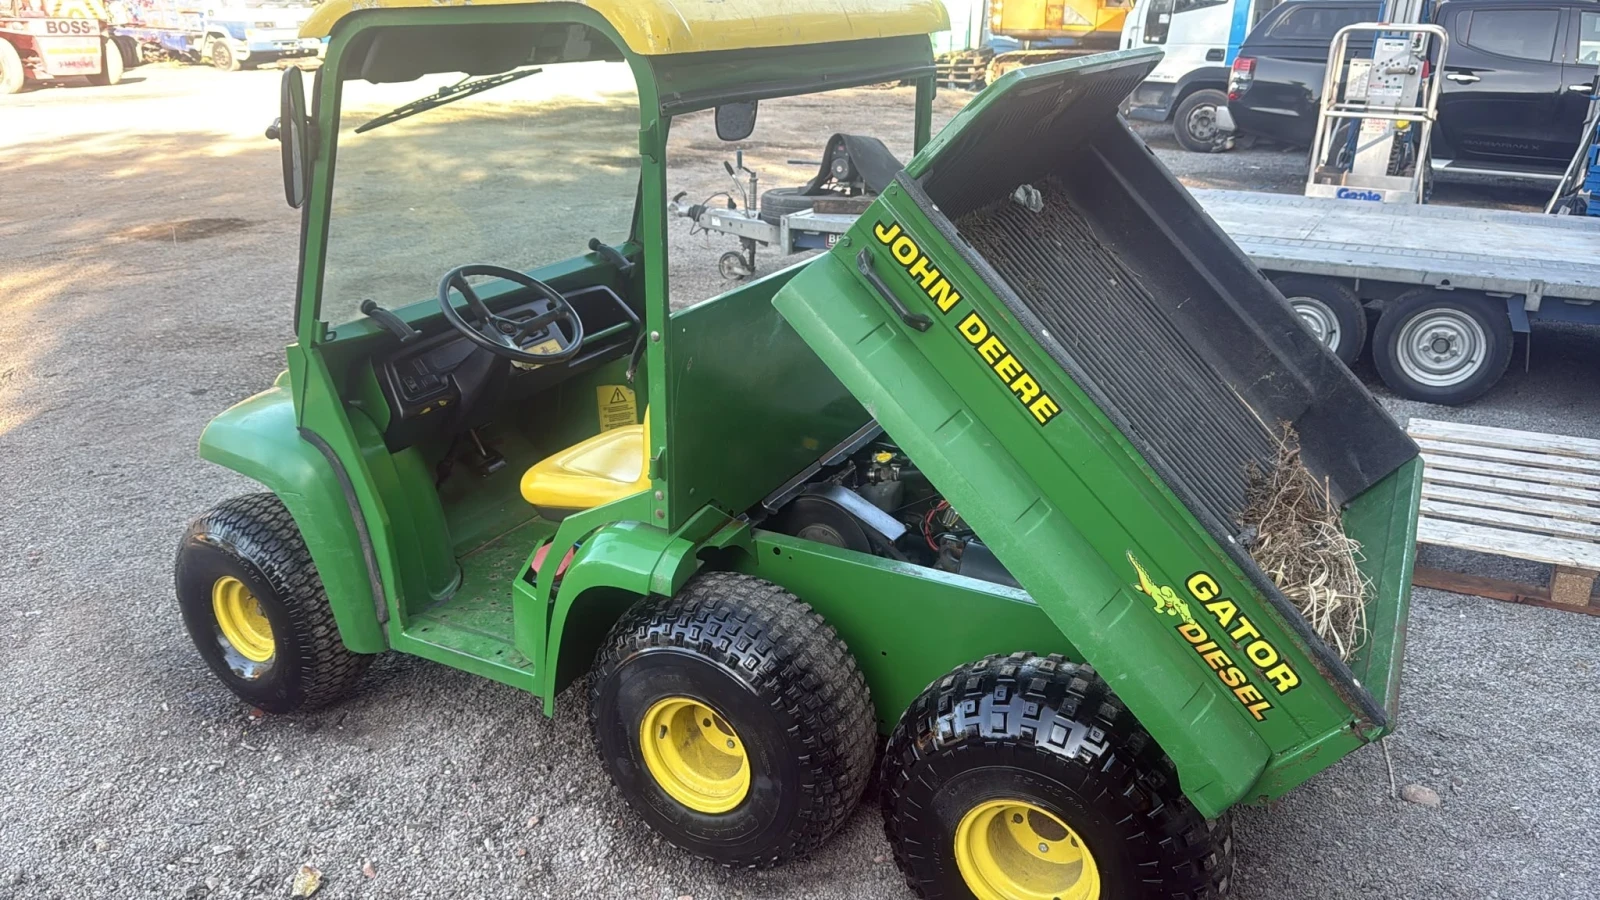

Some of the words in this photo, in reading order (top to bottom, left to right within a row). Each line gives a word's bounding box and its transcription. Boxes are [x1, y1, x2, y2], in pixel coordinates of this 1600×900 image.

[46, 21, 91, 34] BOSS
[1337, 187, 1382, 201] Genie
[873, 220, 964, 315] JOHN
[955, 309, 1063, 427] DEERE
[1174, 619, 1275, 722] DIESEL
[1185, 571, 1302, 696] GATOR
